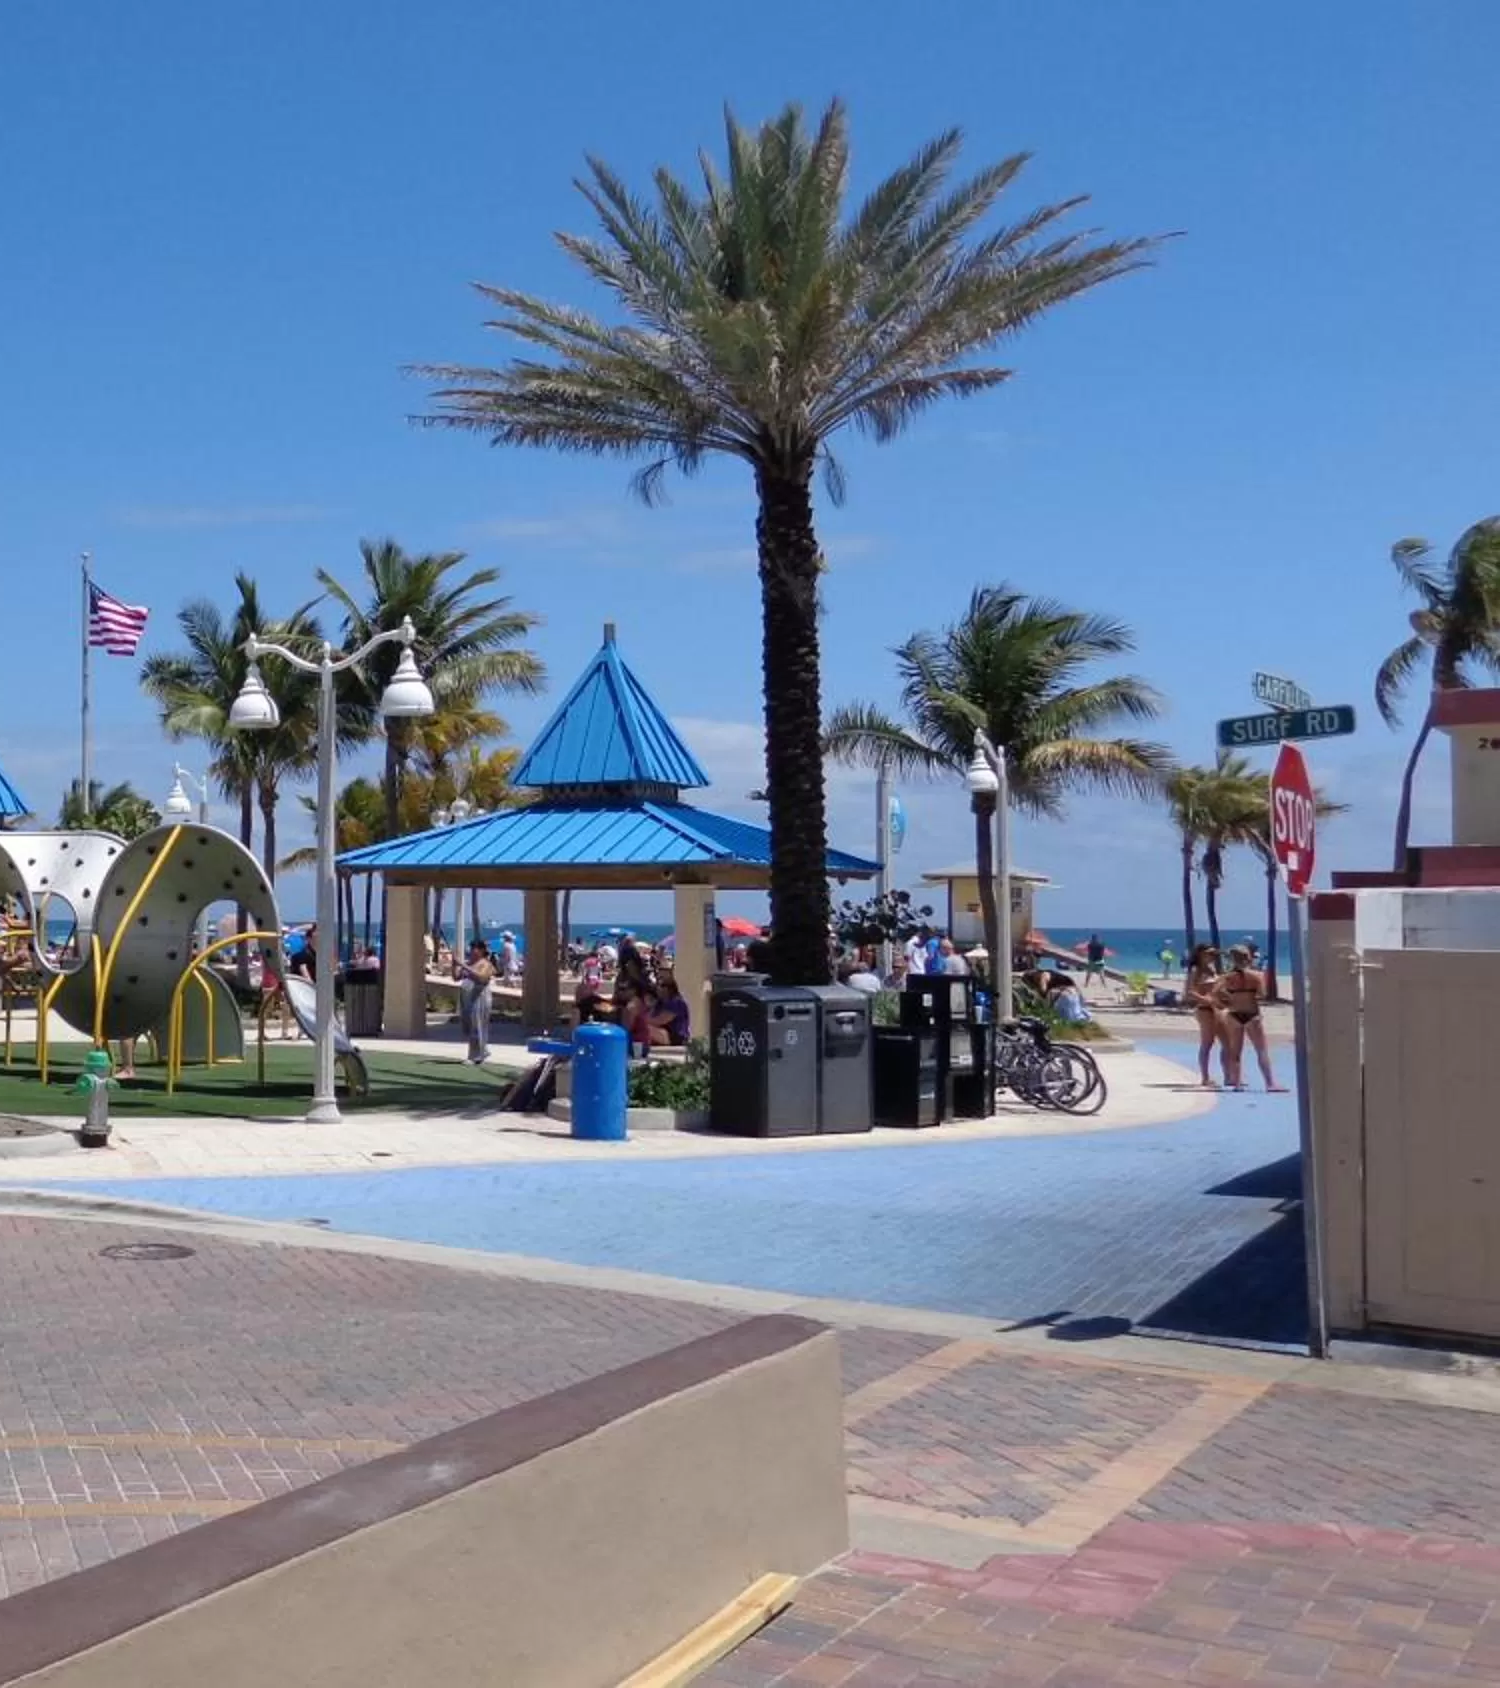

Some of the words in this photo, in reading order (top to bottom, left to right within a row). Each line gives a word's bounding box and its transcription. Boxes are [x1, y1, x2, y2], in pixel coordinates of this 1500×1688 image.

[1231, 715, 1293, 742] SURF
[1305, 711, 1340, 734] RD
[1275, 787, 1313, 851] STOP
